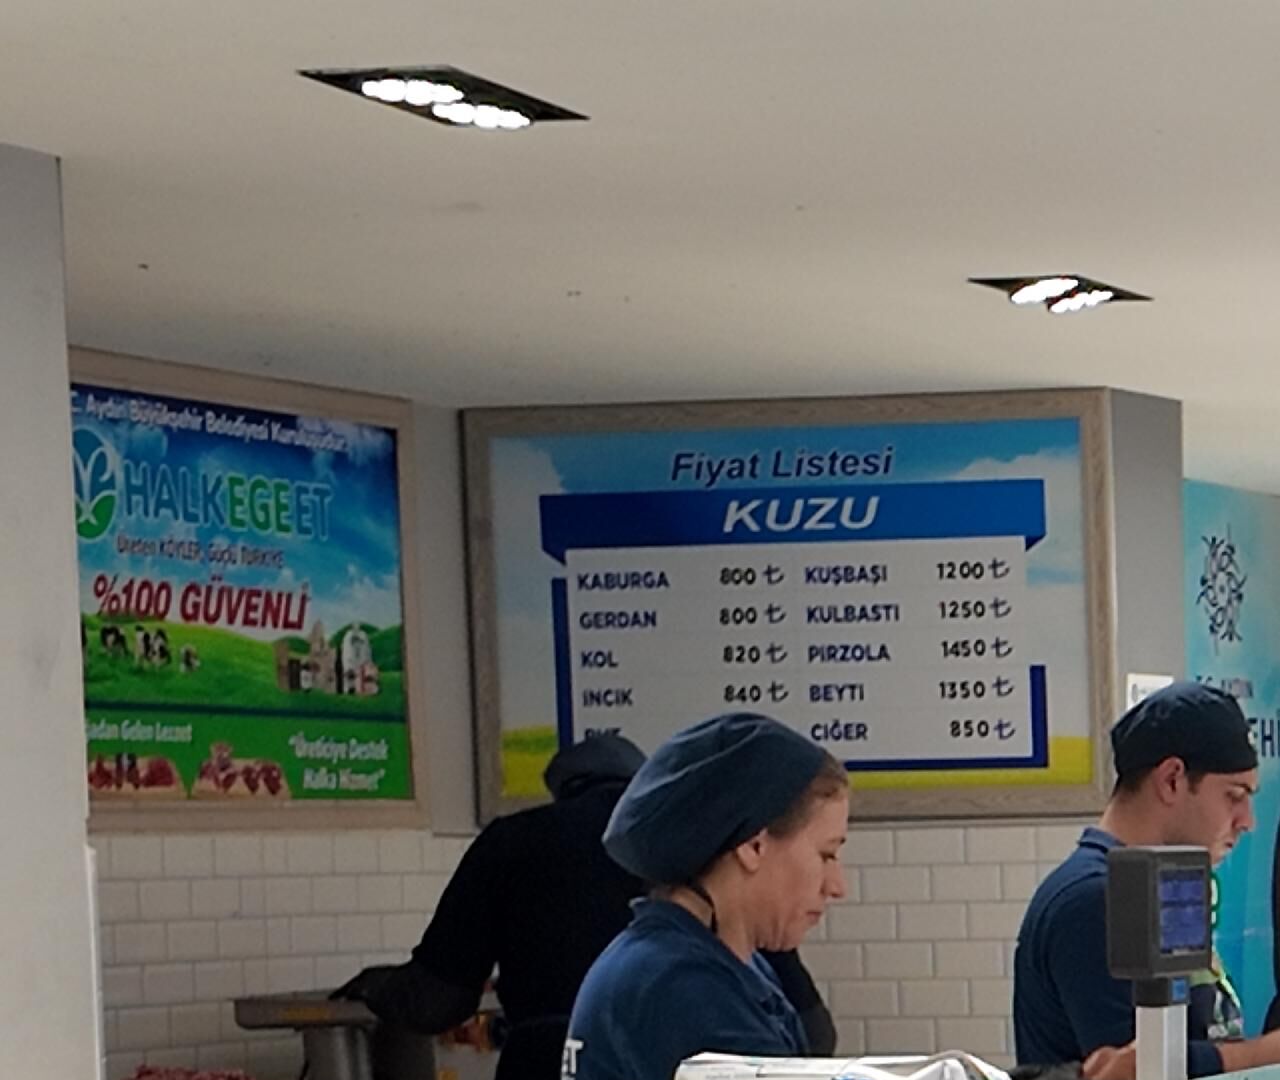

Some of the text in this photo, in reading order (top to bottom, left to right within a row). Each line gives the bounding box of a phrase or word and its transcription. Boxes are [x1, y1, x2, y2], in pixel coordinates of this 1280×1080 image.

[671, 446, 893, 488] Fiyat Listesi
[122, 460, 333, 541] HALKEGEET
[722, 496, 881, 533] KUZU
[577, 571, 670, 591] KABURGA
[719, 567, 757, 586] 800
[804, 564, 888, 587] KUŞBAŞI
[936, 561, 985, 580] 1200
[94, 572, 311, 630] %100 GÜVENLİ
[806, 603, 900, 624] KULBASTI
[939, 601, 986, 619] 1250
[579, 611, 657, 630] GERDAN
[719, 607, 758, 626] 800
[580, 651, 619, 669] KOL
[723, 645, 761, 663] 820
[941, 639, 987, 658] 1450
[723, 684, 762, 703] 840
[938, 680, 987, 699] 1350
[949, 719, 990, 738] 850
